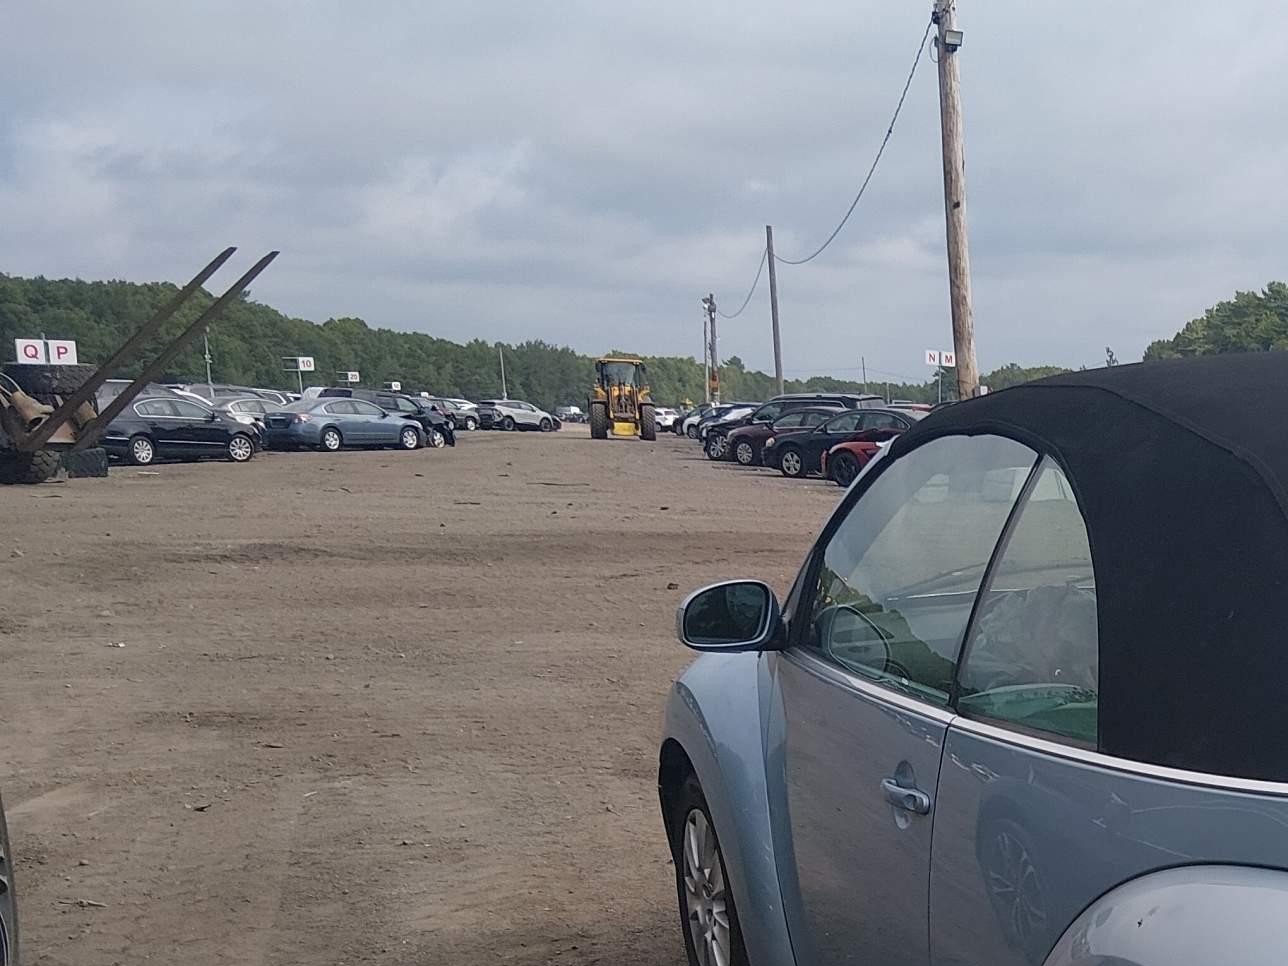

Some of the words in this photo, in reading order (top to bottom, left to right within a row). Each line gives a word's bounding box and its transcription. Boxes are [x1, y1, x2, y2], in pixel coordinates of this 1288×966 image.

[23, 344, 39, 359] Q
[57, 346, 68, 359] P
[928, 352, 936, 362] N
[944, 354, 953, 364] M
[302, 360, 312, 368] 10
